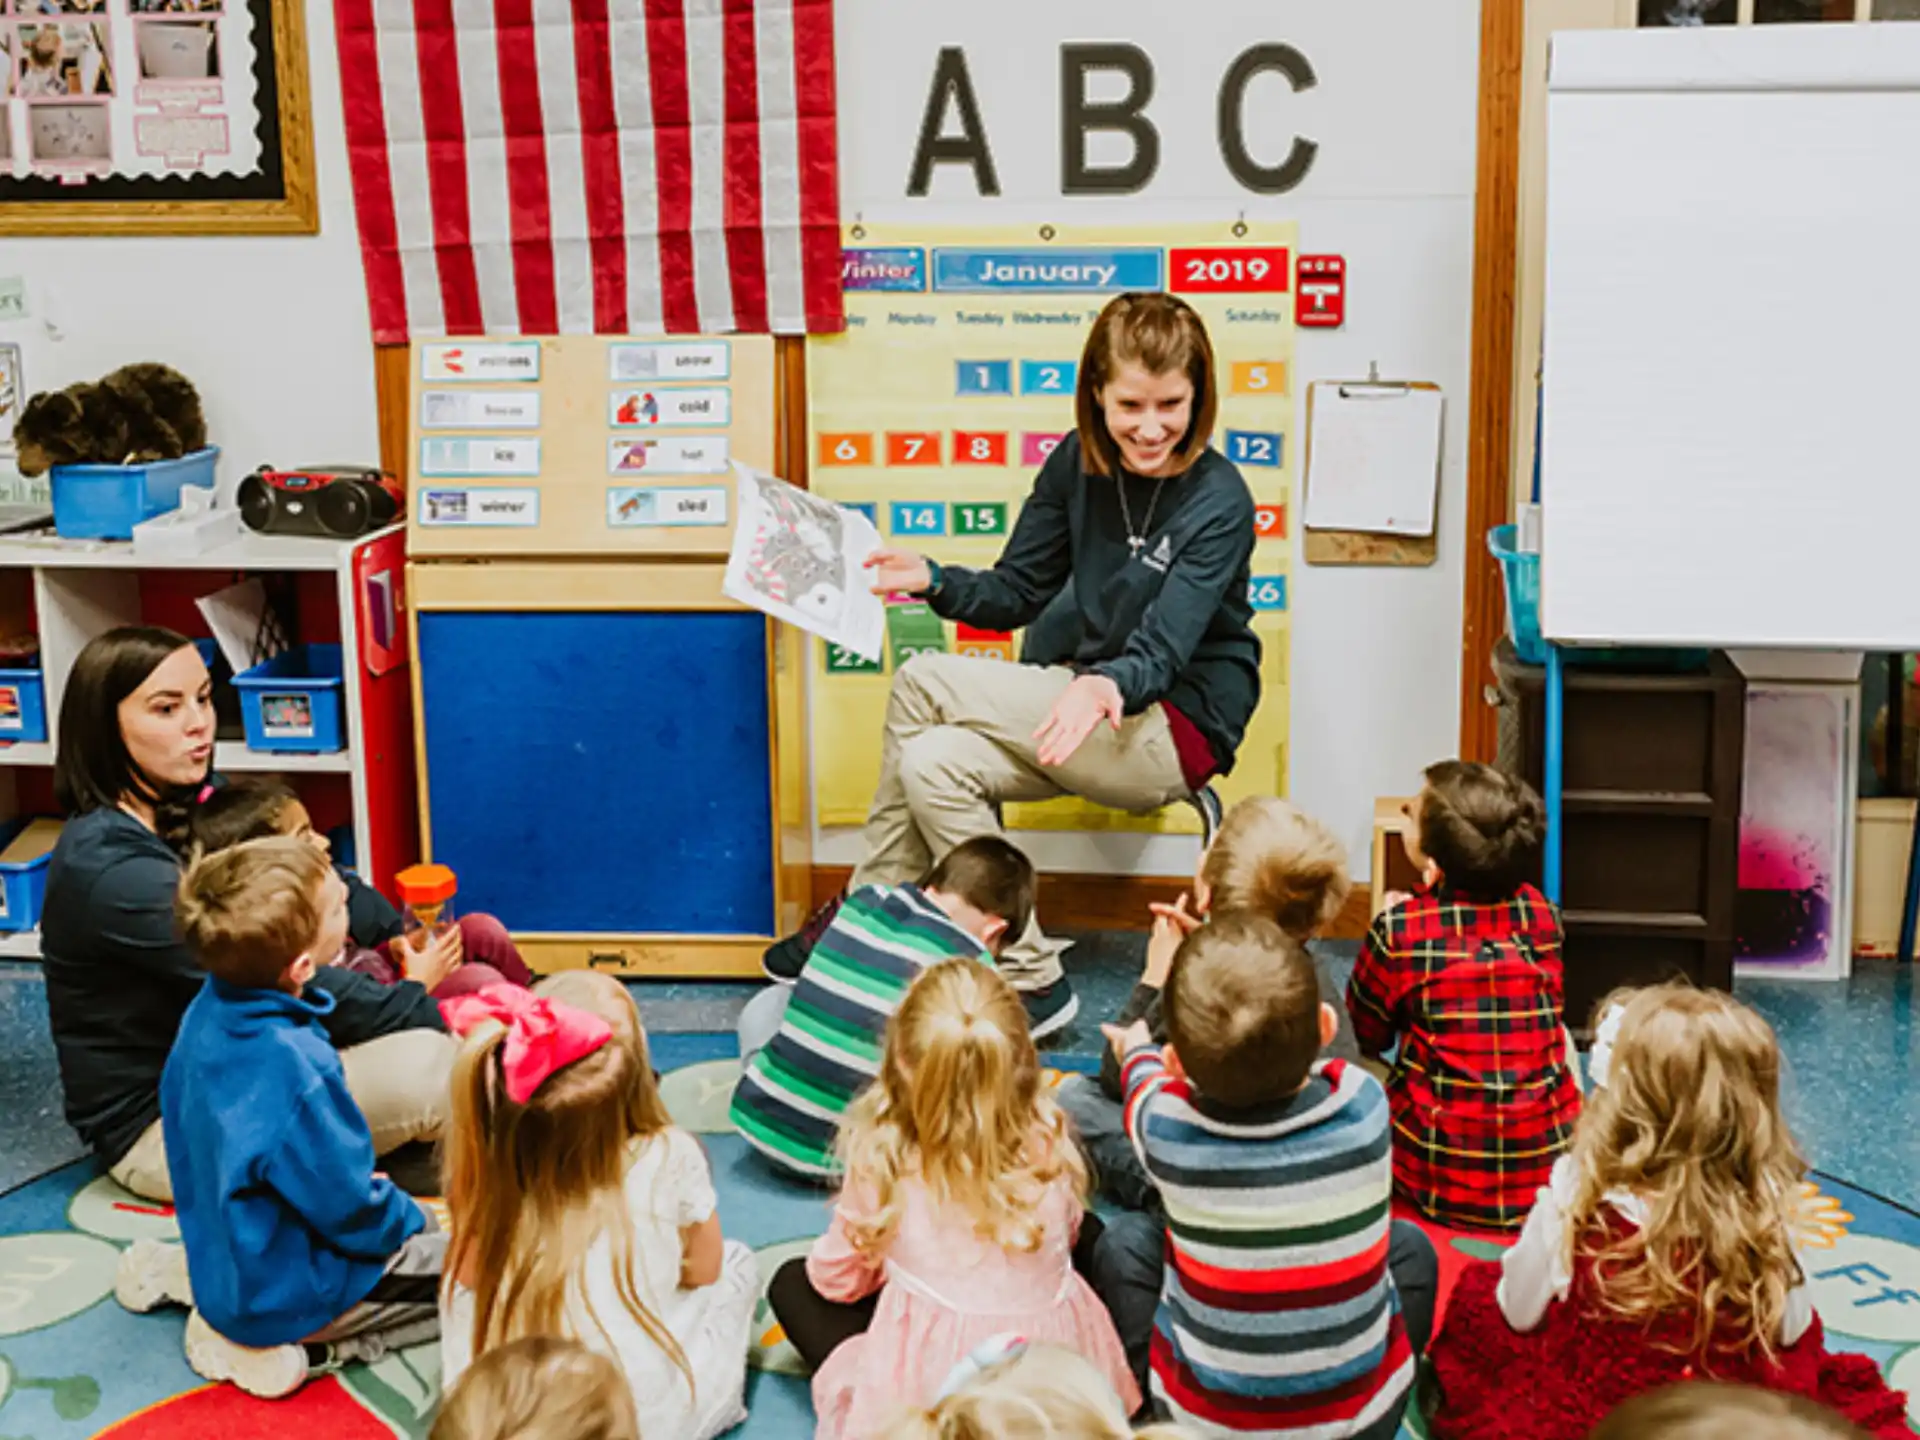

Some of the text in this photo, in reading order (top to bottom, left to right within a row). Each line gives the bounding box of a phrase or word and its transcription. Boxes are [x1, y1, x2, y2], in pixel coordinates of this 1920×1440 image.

[906, 42, 1319, 197] A B C
[978, 260, 1117, 287] January
[1185, 257, 1270, 281] 2019
[888, 312, 937, 326] Monday
[956, 311, 1004, 326] Tuesday
[1012, 311, 1081, 326] Wednesday
[1225, 308, 1281, 323] Saturday
[975, 366, 1269, 389] 1 2 5
[834, 440, 857, 459] 6
[904, 439, 924, 459] 7
[970, 437, 991, 459] 8
[1234, 437, 1271, 459] 12
[900, 508, 936, 529] 14
[962, 508, 997, 530] 15
